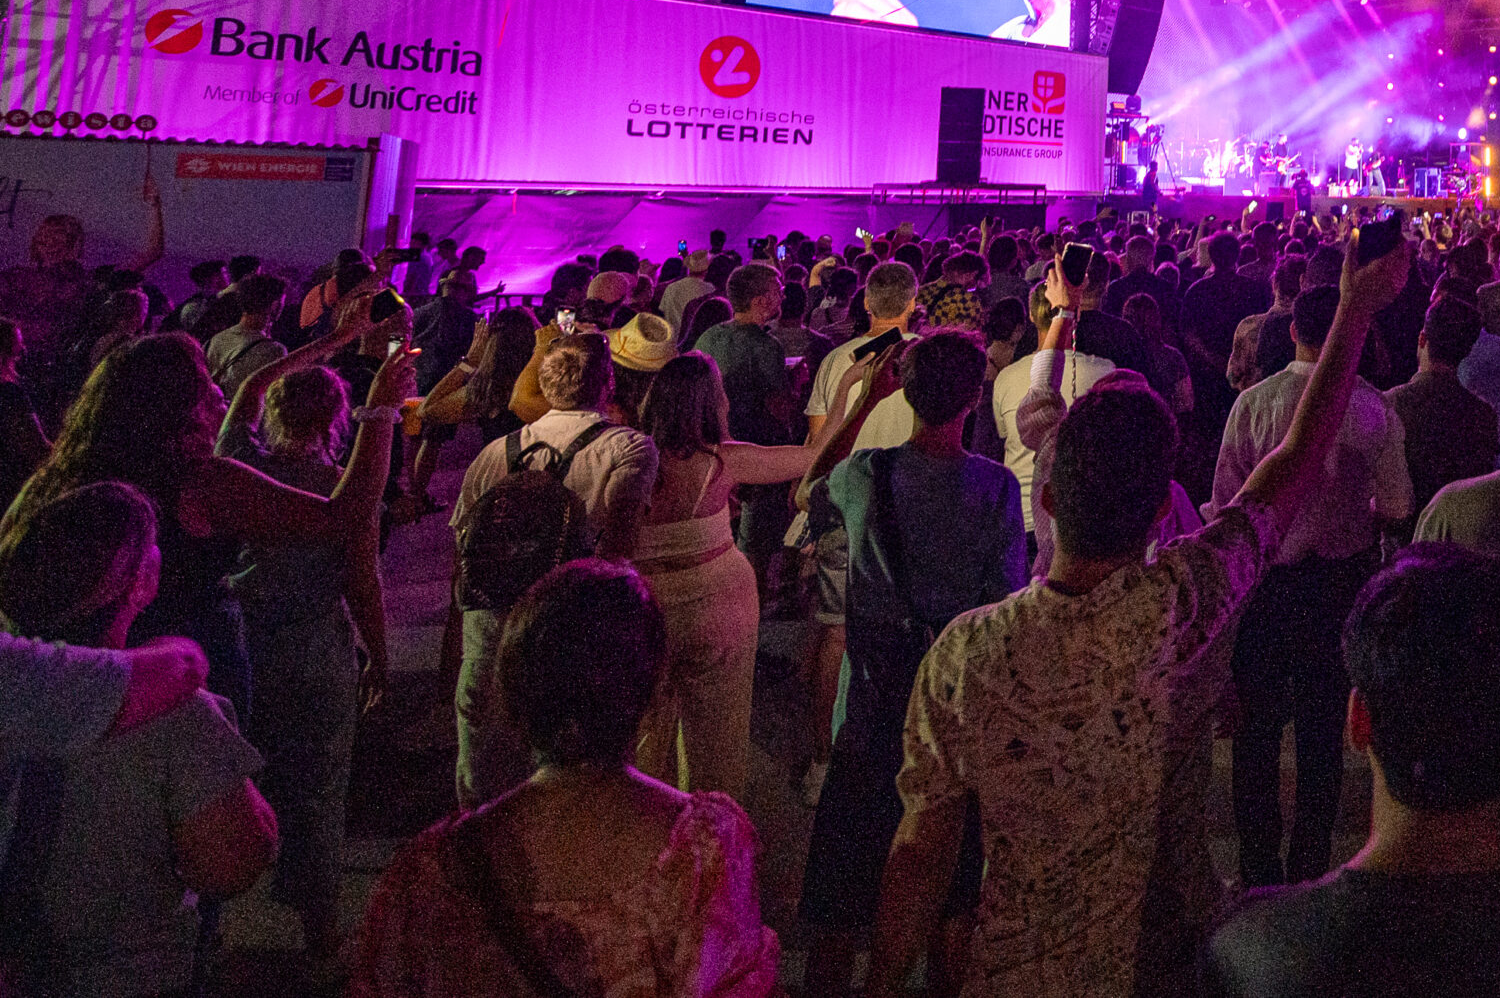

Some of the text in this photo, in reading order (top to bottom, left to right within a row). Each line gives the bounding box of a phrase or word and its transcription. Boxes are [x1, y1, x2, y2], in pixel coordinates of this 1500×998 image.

[210, 17, 482, 77] Bank Austria
[203, 85, 301, 106] Member of
[350, 83, 478, 115] UniCredit
[987, 90, 1029, 112] NER
[628, 99, 815, 125] österreichische
[626, 119, 814, 145] LOTTERIEN
[983, 115, 1065, 138] DTISCHE
[983, 147, 1063, 159] NSURANCE GROUP
[217, 161, 256, 172] WIEN
[260, 162, 318, 174] ENERGIE
